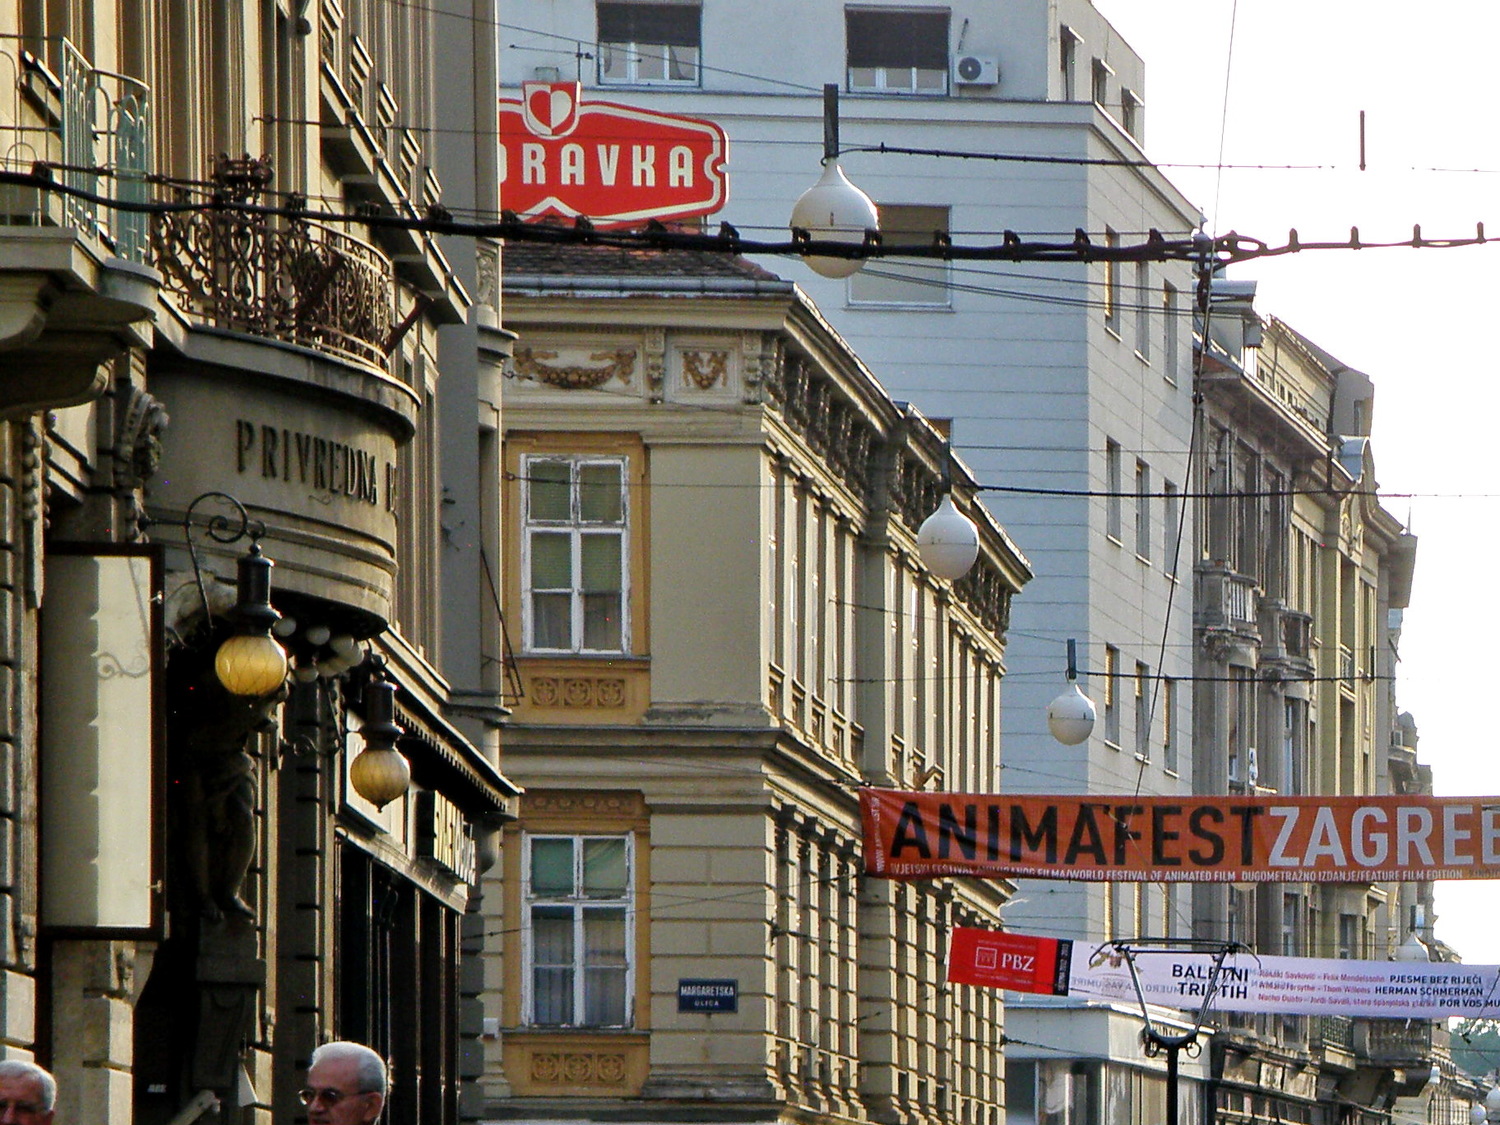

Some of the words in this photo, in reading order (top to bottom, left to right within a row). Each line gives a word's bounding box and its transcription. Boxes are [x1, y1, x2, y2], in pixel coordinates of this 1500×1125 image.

[236, 419, 378, 506] PRIVREDNA
[889, 801, 1264, 867] ANIMAFEST
[1106, 870, 1148, 882] FESTIVAL
[1150, 870, 1162, 882] OF
[1164, 870, 1212, 882] ANIMATED
[1213, 870, 1236, 882] FILM
[1402, 869, 1424, 881] FILM
[1426, 869, 1463, 881] EDITION
[1001, 952, 1035, 972] PBZ
[1389, 974, 1427, 984] PJESME
[1430, 975, 1449, 984] BEZ
[680, 985, 735, 997] MARGARETSKA
[1375, 986, 1418, 996] HERMAN
[1420, 986, 1483, 996] SCHMERMAN
[1439, 999, 1460, 1008] POR
[1462, 999, 1483, 1008] VOS
